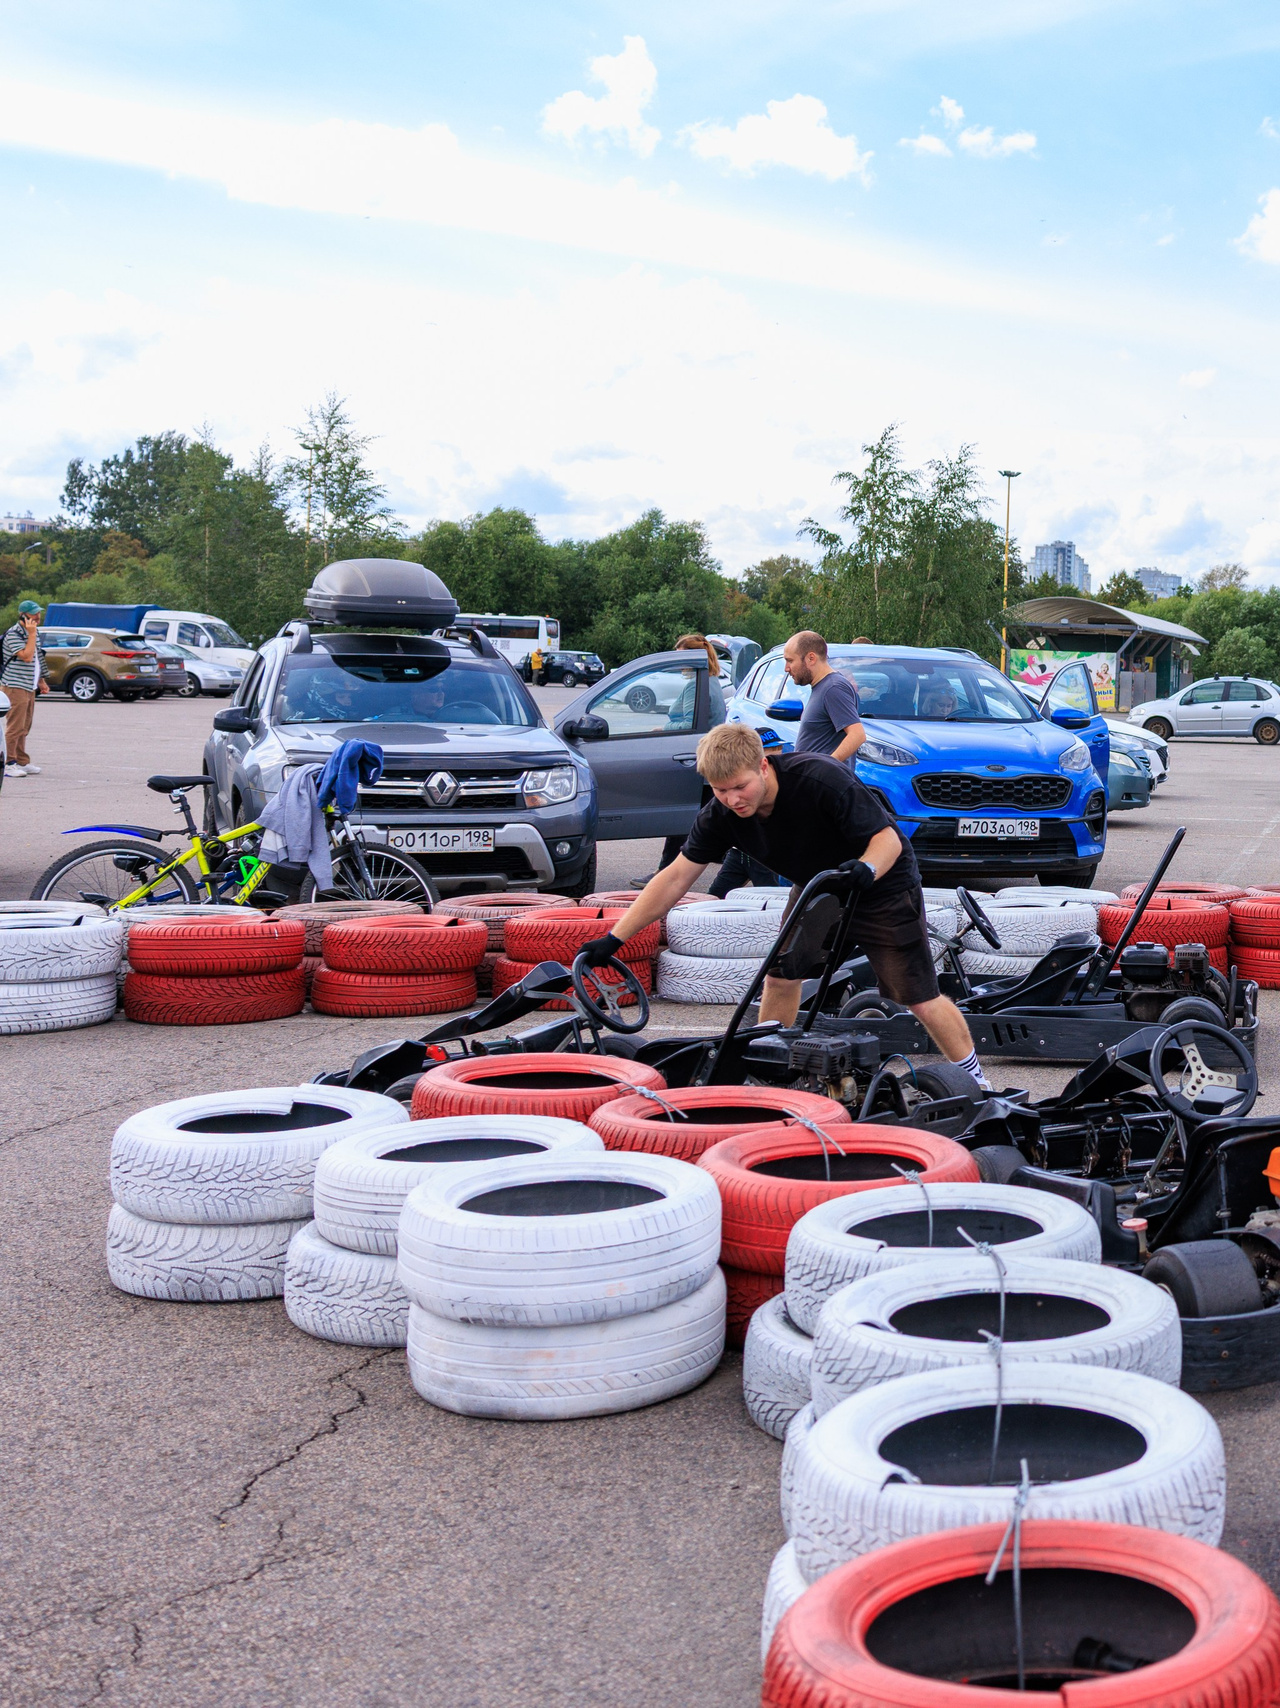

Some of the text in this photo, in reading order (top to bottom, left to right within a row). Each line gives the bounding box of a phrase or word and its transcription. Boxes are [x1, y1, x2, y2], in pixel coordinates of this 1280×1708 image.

[962, 821, 1036, 834] М703АО 198
[394, 831, 489, 847] О011ОР 198
